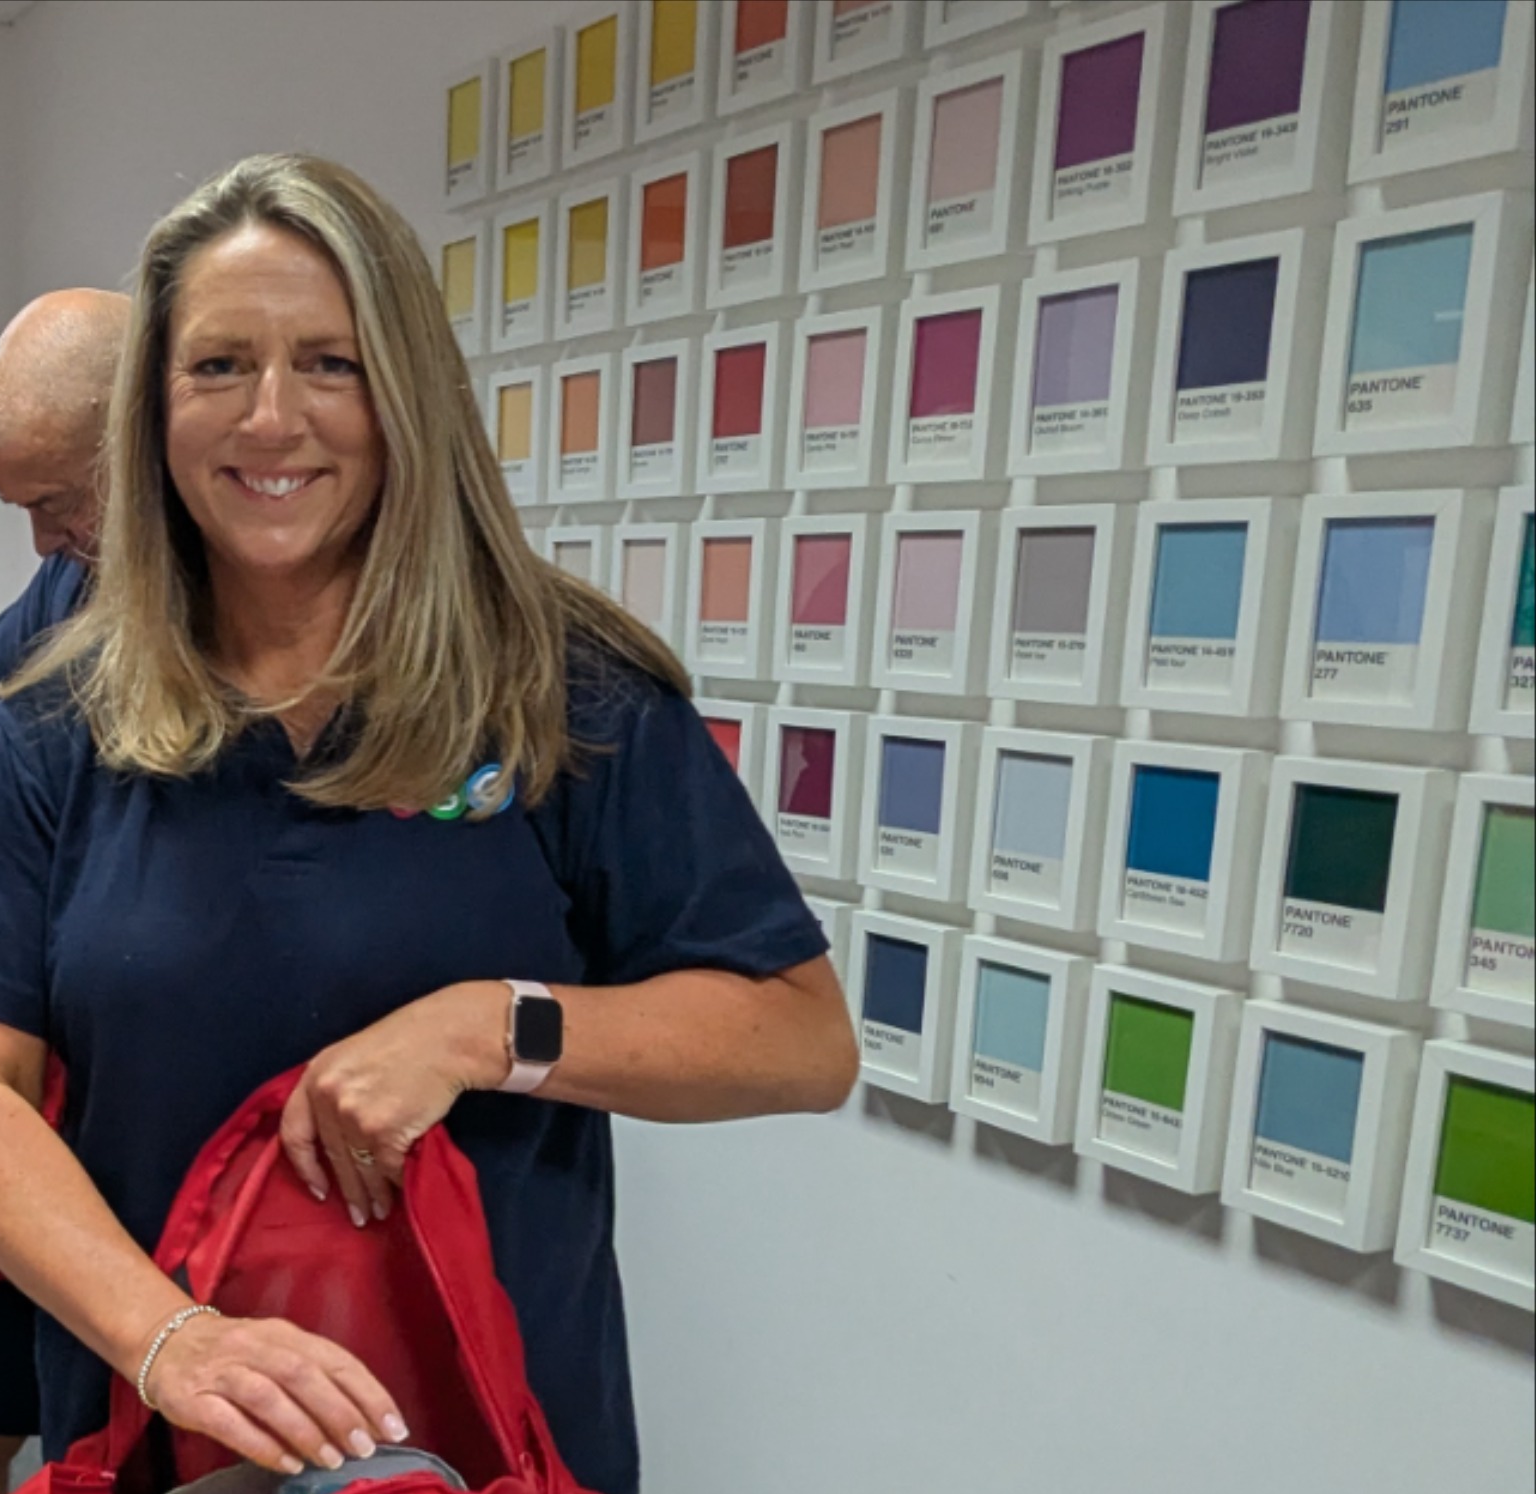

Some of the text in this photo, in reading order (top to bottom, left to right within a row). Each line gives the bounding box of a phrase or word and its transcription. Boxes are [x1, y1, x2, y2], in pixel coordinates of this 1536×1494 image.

[1387, 84, 1465, 115] PANTONE
[1385, 117, 1409, 135] 291
[1205, 130, 1257, 151] PANTONE
[931, 199, 975, 219] PANTONE
[1349, 375, 1419, 395] PANTONE
[1347, 399, 1372, 413] 635
[894, 635, 938, 648] PANTONE
[1151, 644, 1198, 656] PANTONE
[1316, 649, 1385, 667] PANTONE
[1314, 667, 1338, 679] 277
[992, 855, 1042, 875] PANTONE
[1127, 875, 1173, 893] PANTONE
[1285, 905, 1352, 929] PANTONE
[1283, 924, 1313, 938] 7720
[1469, 955, 1497, 971] 345
[1102, 1097, 1147, 1116] PANTONE
[1255, 1143, 1308, 1169] PANTONE
[1438, 1205, 1514, 1239] PANTONE
[1436, 1223, 1469, 1241] 7737
